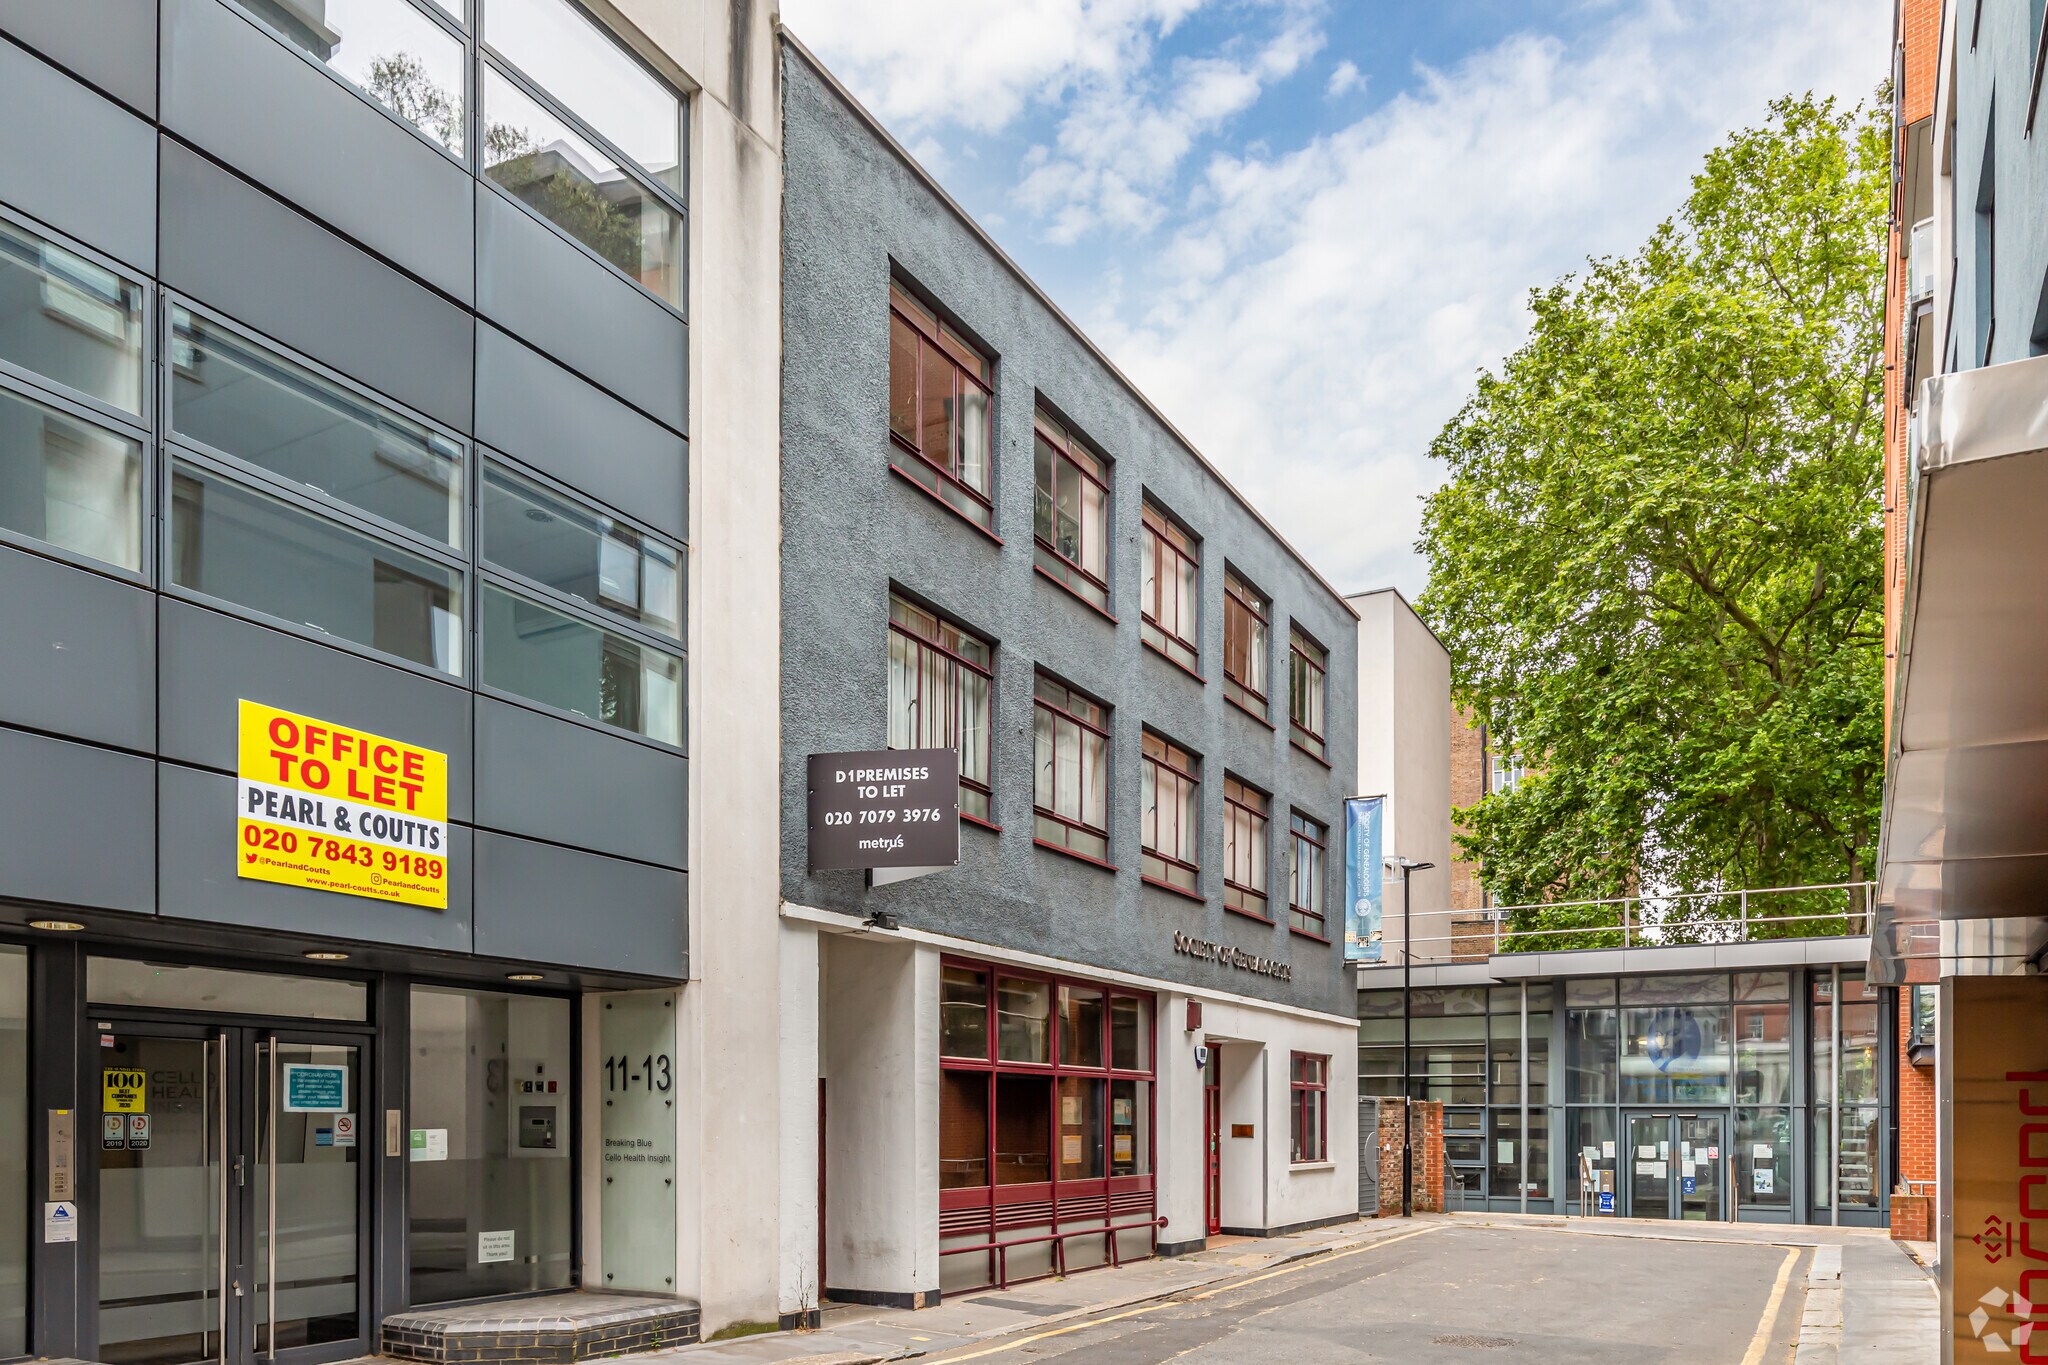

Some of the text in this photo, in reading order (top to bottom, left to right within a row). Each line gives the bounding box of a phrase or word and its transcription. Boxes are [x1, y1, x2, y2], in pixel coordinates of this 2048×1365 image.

[269, 717, 425, 782] OFFICE
[270, 750, 423, 811] TO LET
[857, 784, 906, 798] TO LET
[248, 786, 440, 850] PEARL & COUTTS
[825, 808, 941, 825] 020 7079 3976
[244, 825, 442, 880] 020 7843 9189
[1362, 811, 1371, 897] SOCIETY OF GENEALOGISTS
[259, 856, 331, 875] @PearlandCoutts
[306, 876, 400, 897] www.pearl-coutts.co.uk
[383, 877, 440, 894] PearlandCoutts
[106, 1072, 144, 1088] 100
[605, 1054, 672, 1091] 11-13
[605, 1139, 652, 1148] Breaking Blue
[604, 1153, 671, 1163] Cello Health Insight
